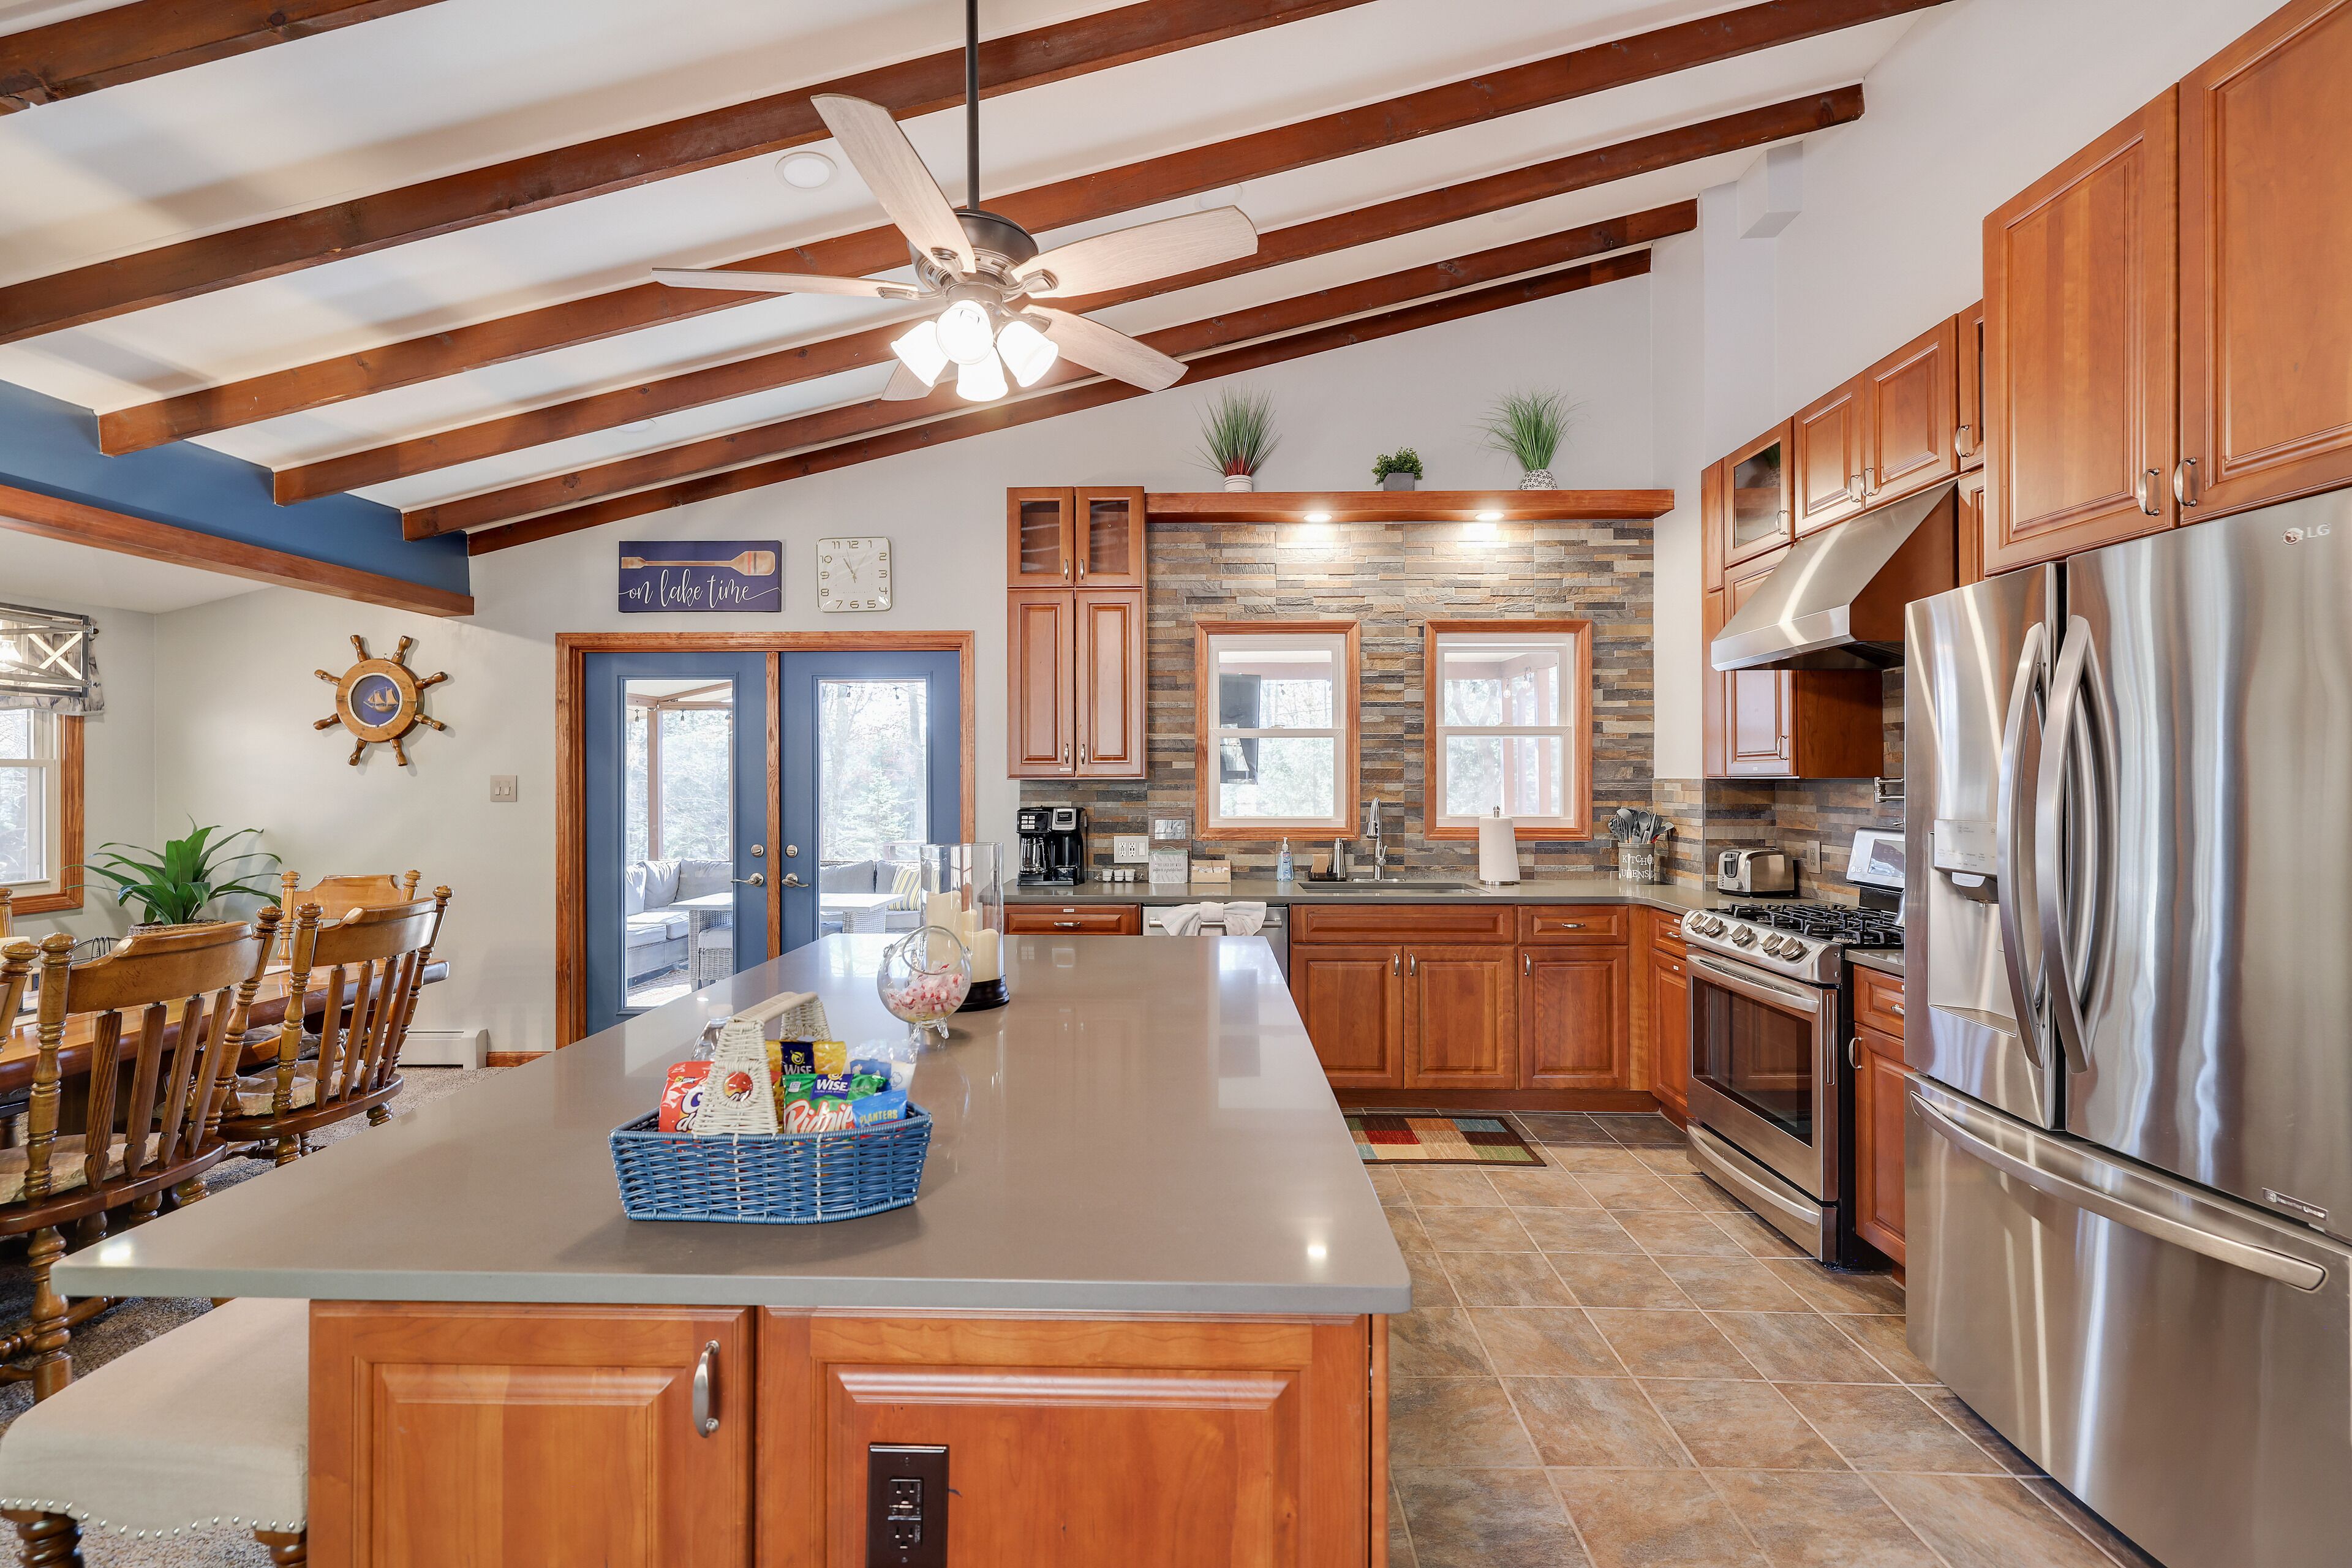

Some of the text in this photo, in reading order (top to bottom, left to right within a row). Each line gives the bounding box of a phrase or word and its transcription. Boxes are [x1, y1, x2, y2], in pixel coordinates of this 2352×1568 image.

[2306, 523, 2332, 539] LG
[847, 540, 859, 549] 12
[868, 540, 872, 548] 1
[820, 555, 832, 564] 10
[879, 552, 887, 561] 2
[820, 571, 829, 579] 9
[878, 570, 888, 578] 3
[628, 568, 752, 609] on lake time
[820, 588, 829, 597] 8
[835, 600, 843, 609] 7
[850, 600, 859, 609] 6
[867, 600, 876, 608] 5
[1621, 869, 1654, 880] UTENSIL
[784, 1065, 812, 1075] WISE
[816, 1079, 848, 1092] WISE
[859, 1109, 898, 1125] PLANTERS
